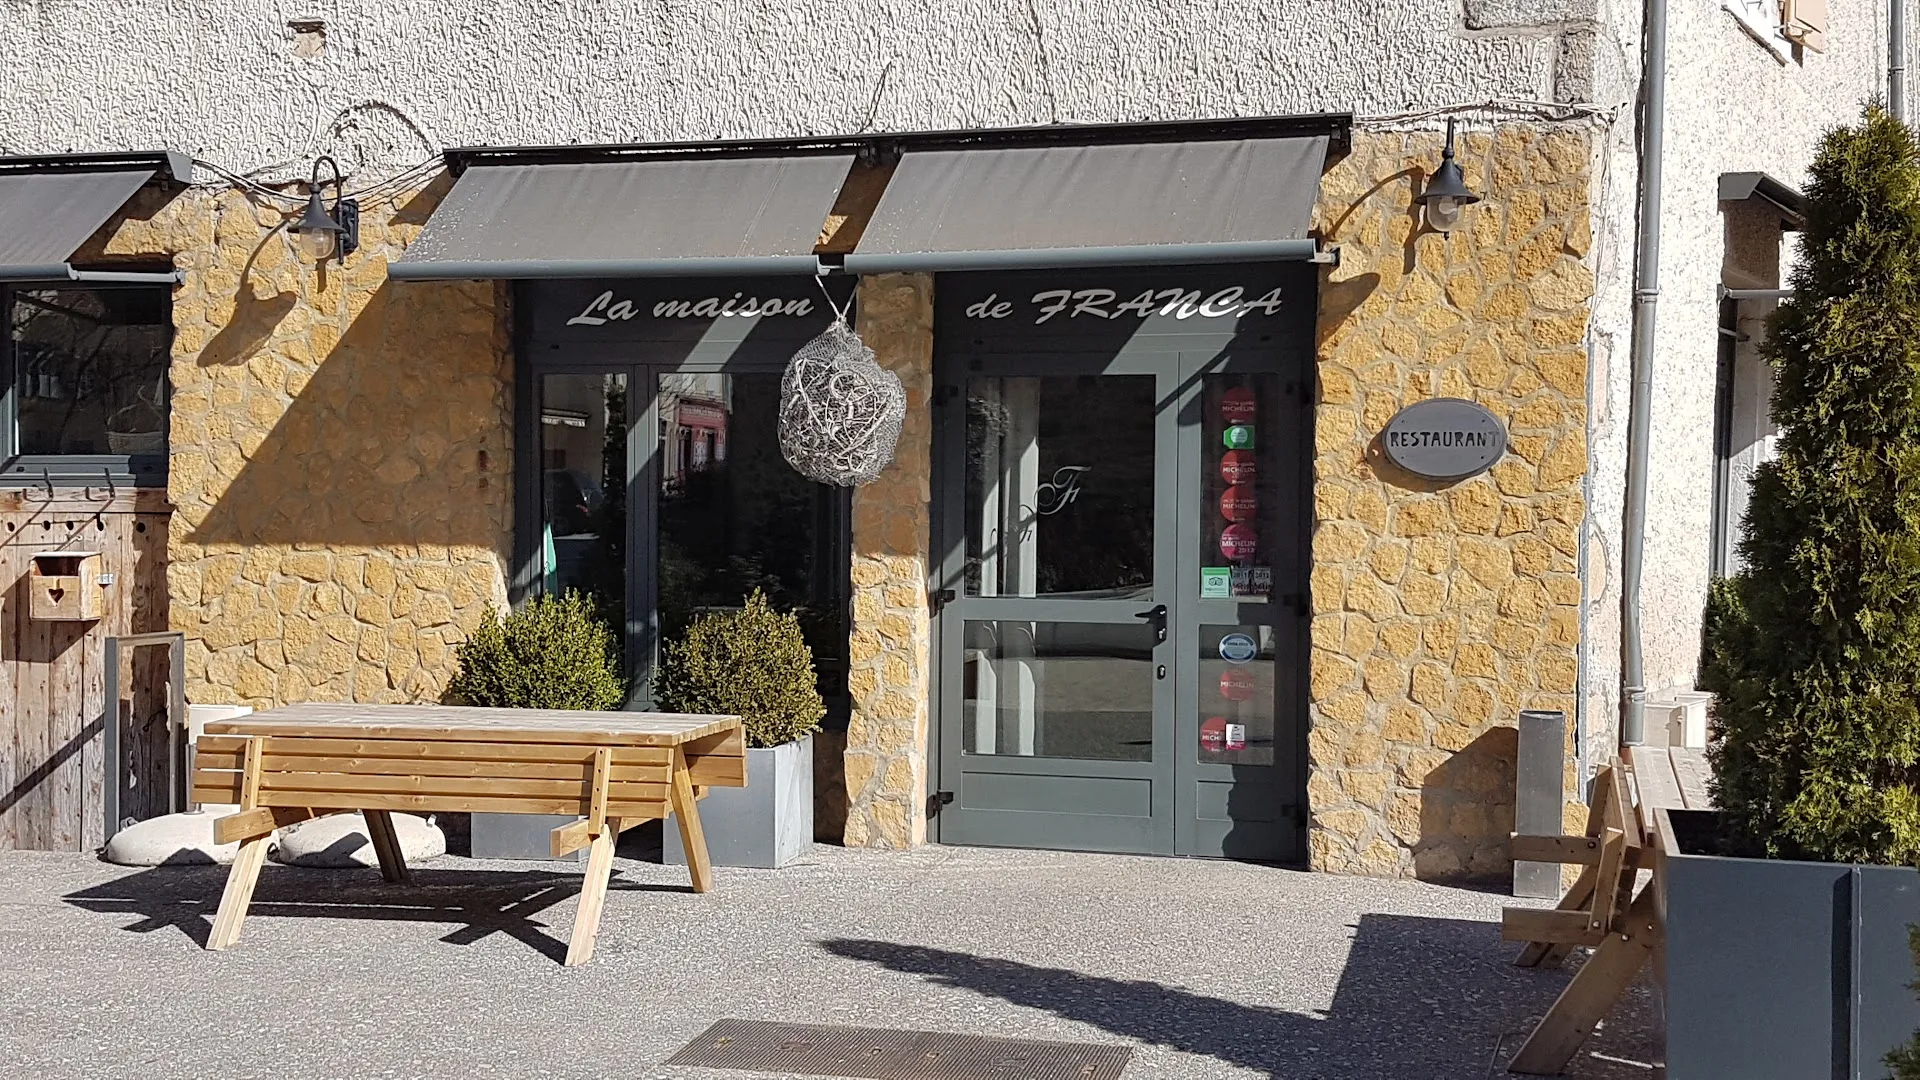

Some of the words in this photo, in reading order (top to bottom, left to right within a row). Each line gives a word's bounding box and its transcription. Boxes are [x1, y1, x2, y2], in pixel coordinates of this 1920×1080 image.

[566, 290, 639, 326] La
[652, 292, 815, 318] maison
[965, 293, 1014, 319] de
[1031, 286, 1283, 325] FRANCA
[1390, 431, 1500, 448] RESTAURANT
